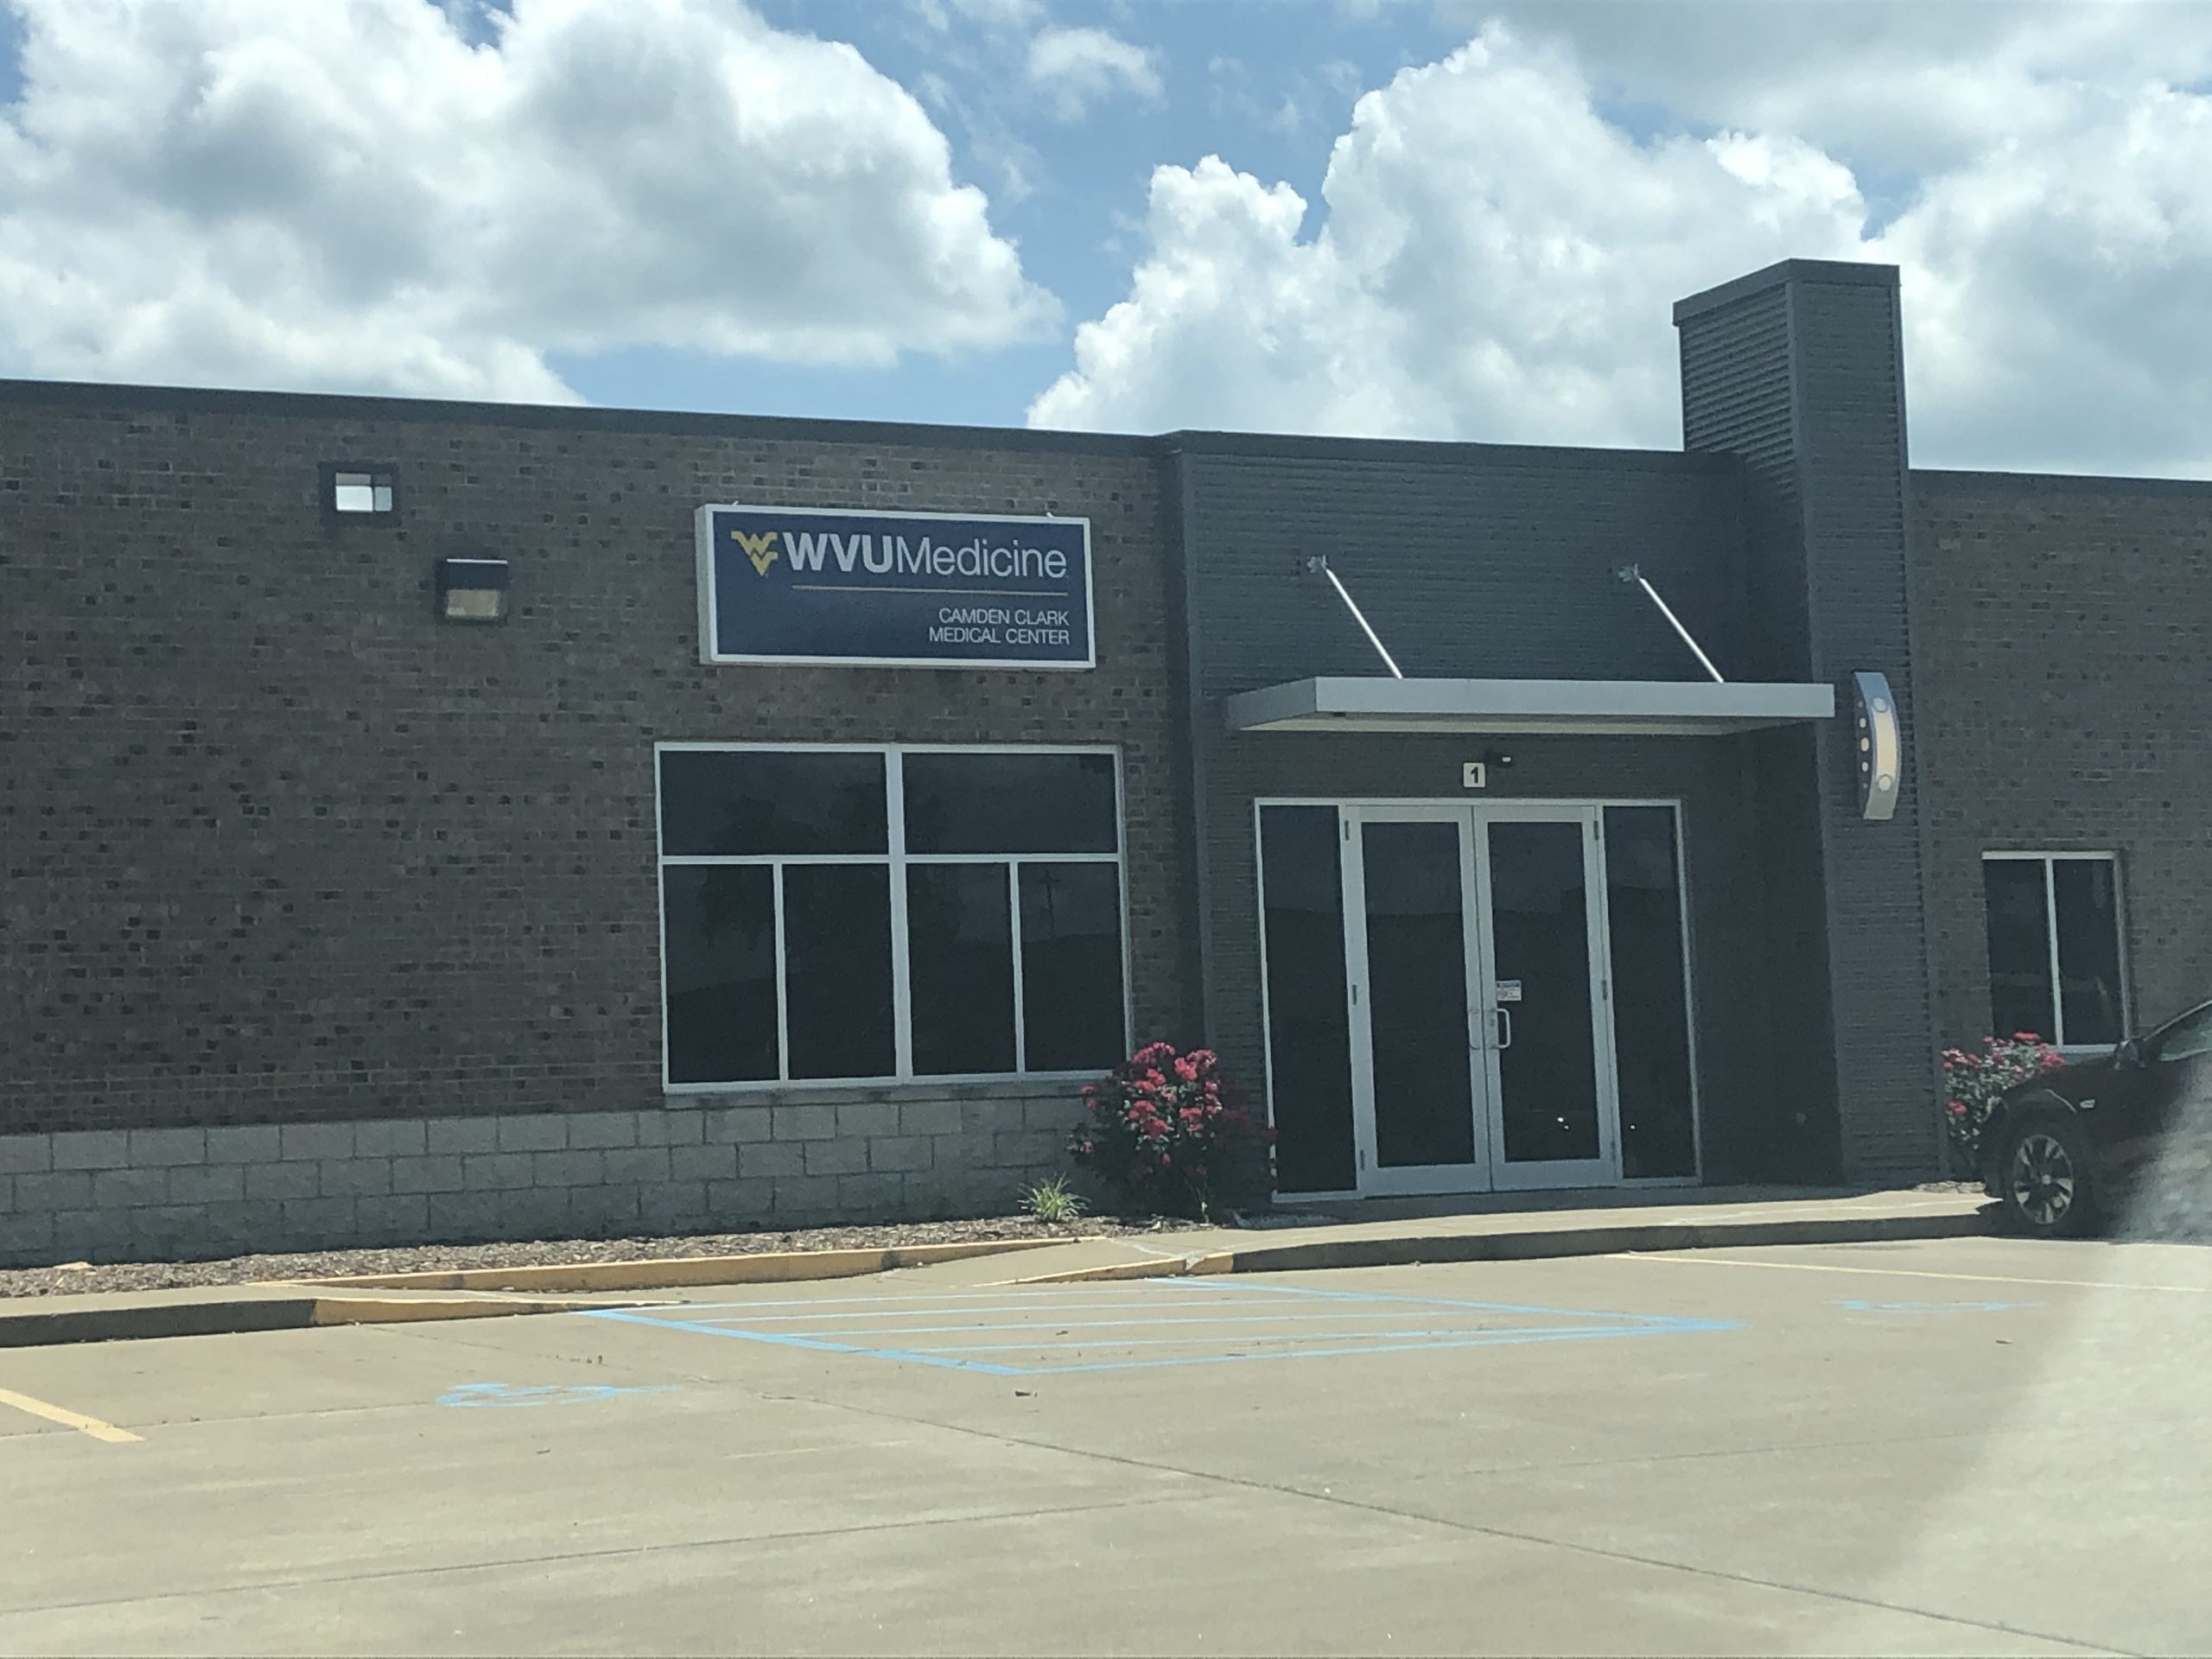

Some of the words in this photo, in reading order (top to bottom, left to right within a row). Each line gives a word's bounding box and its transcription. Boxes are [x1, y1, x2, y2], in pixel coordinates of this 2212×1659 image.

[938, 607, 1010, 625] CAMDEN
[1014, 610, 1070, 626] CLARK
[930, 627, 1001, 644] MEDICAL
[1006, 629, 1070, 645] CENTER
[1471, 766, 1478, 784] 1
